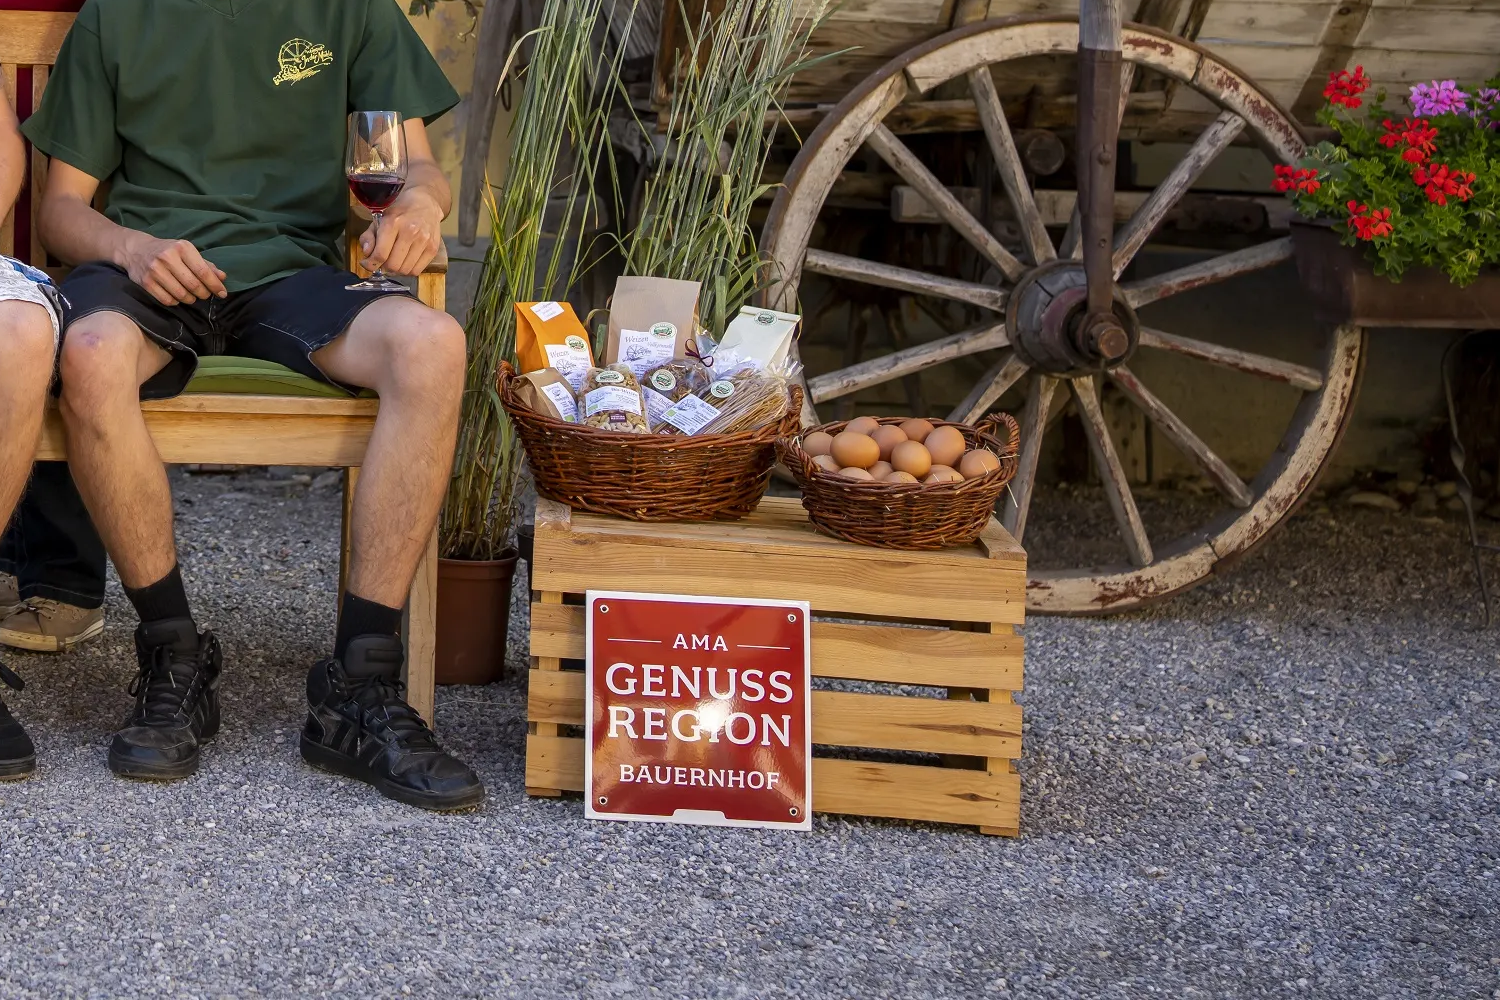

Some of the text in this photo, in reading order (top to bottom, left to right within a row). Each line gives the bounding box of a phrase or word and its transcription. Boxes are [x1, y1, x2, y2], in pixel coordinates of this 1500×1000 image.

[672, 634, 728, 651] AMA
[606, 662, 792, 703] GENUSS
[620, 764, 779, 790] BAUERNHOF
